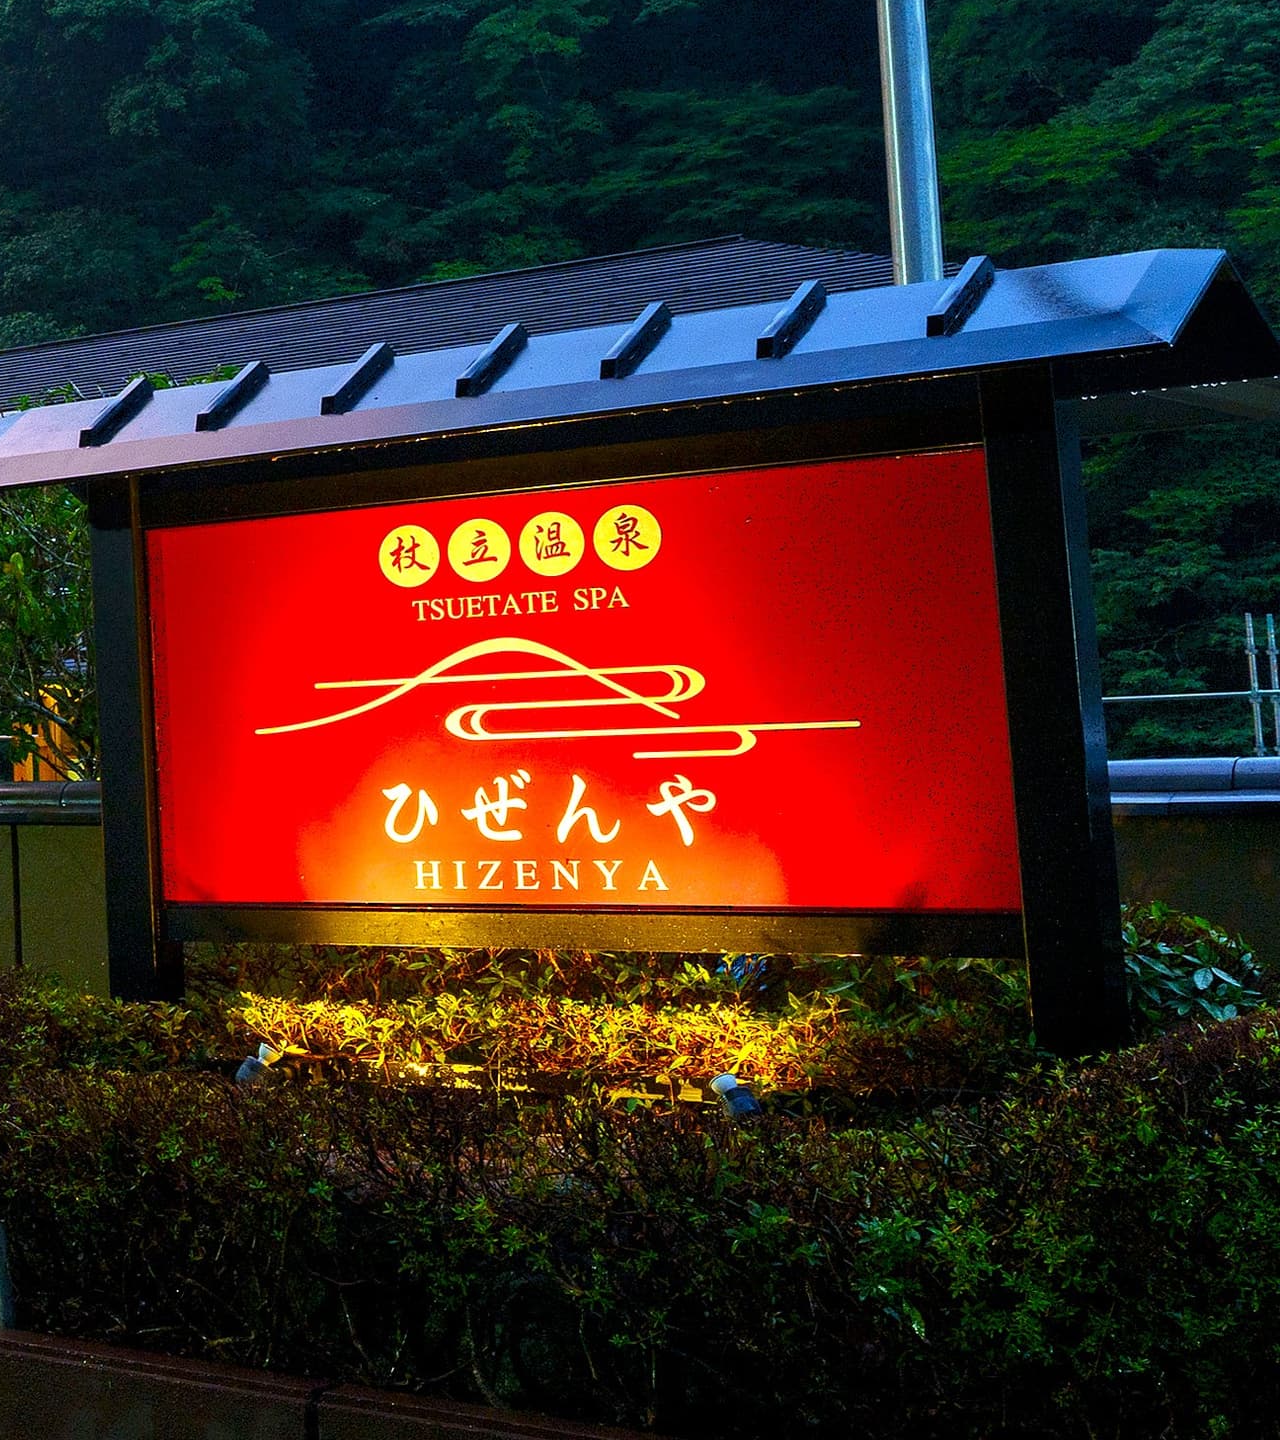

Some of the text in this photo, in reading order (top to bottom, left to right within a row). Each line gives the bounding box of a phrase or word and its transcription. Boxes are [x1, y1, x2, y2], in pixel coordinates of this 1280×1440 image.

[389, 512, 649, 573] 杖立温泉
[411, 586, 630, 622] TSUETATE SPA
[381, 768, 717, 847] ひぜんや
[413, 859, 669, 891] HIZENYA
